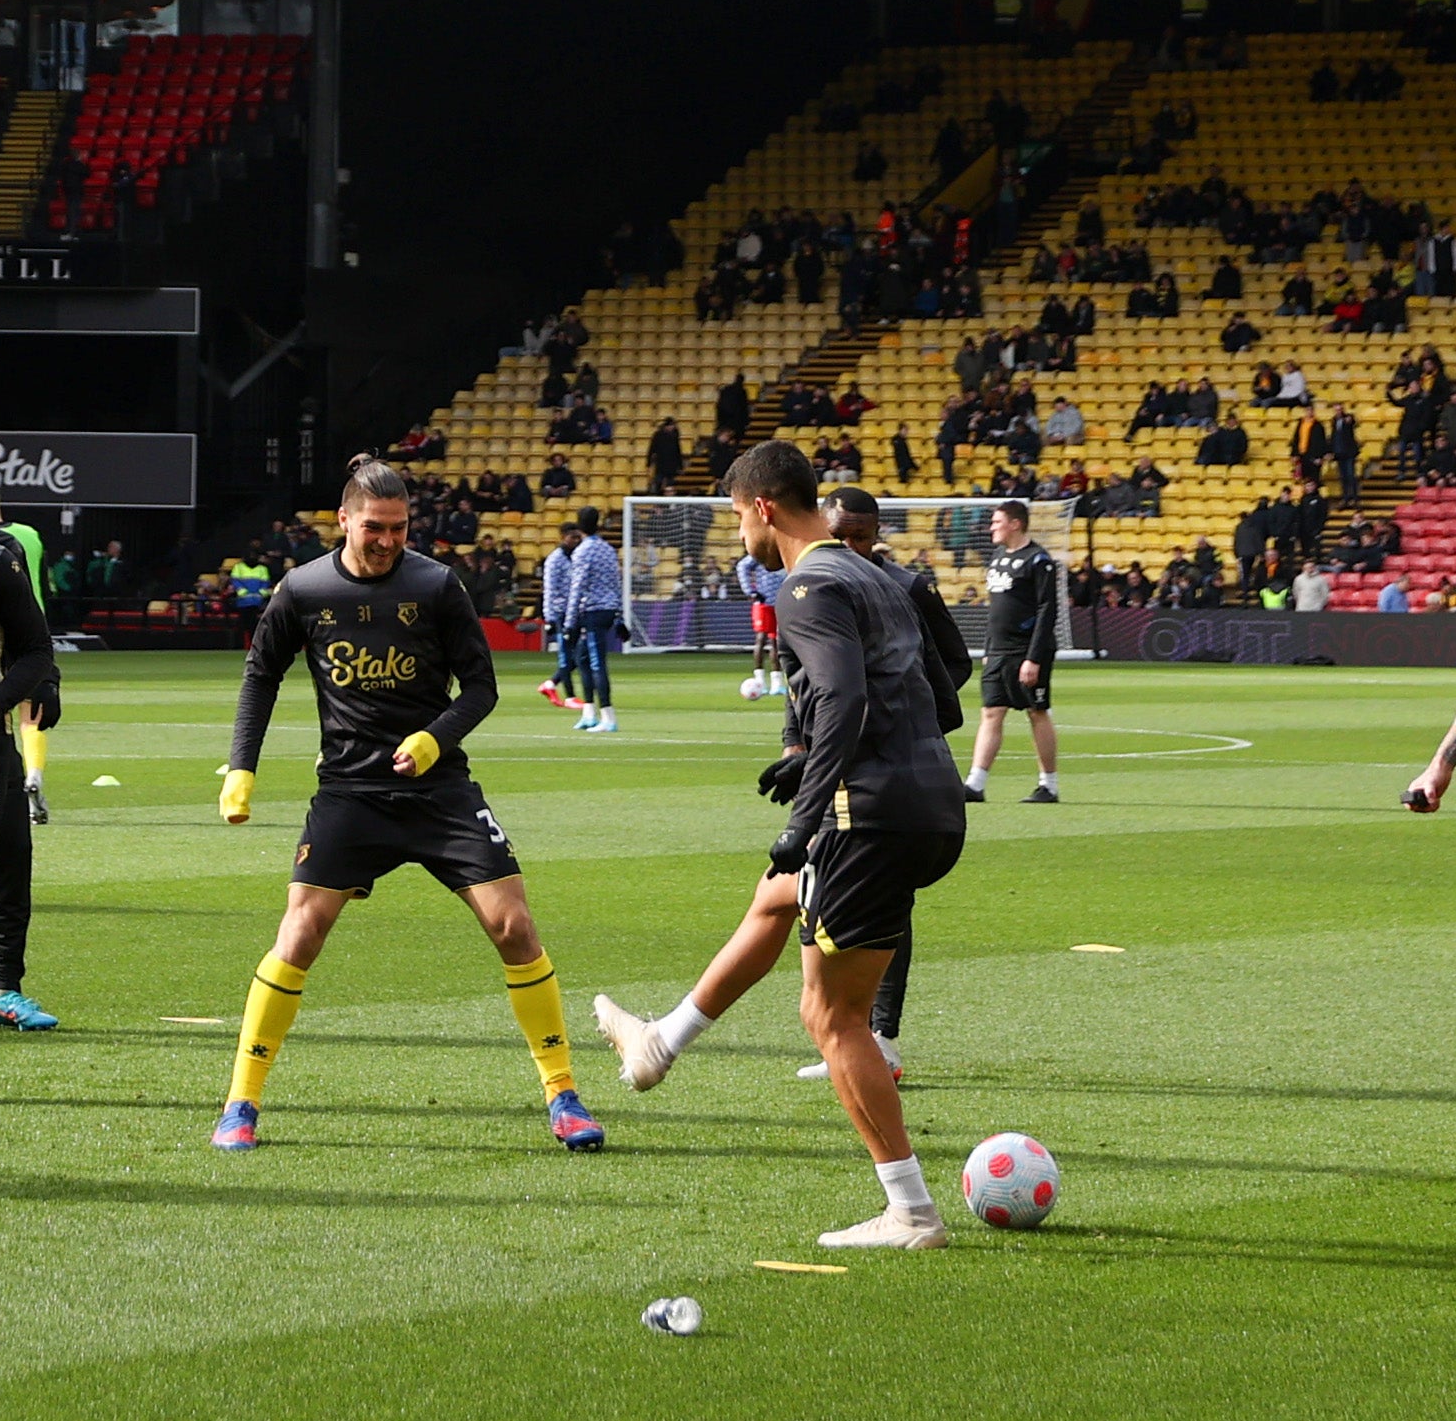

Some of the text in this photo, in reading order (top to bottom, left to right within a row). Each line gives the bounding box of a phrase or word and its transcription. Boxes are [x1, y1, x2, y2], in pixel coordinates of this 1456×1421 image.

[357, 604, 372, 622] 31
[327, 640, 417, 687] Stake
[358, 678, 396, 692] .com
